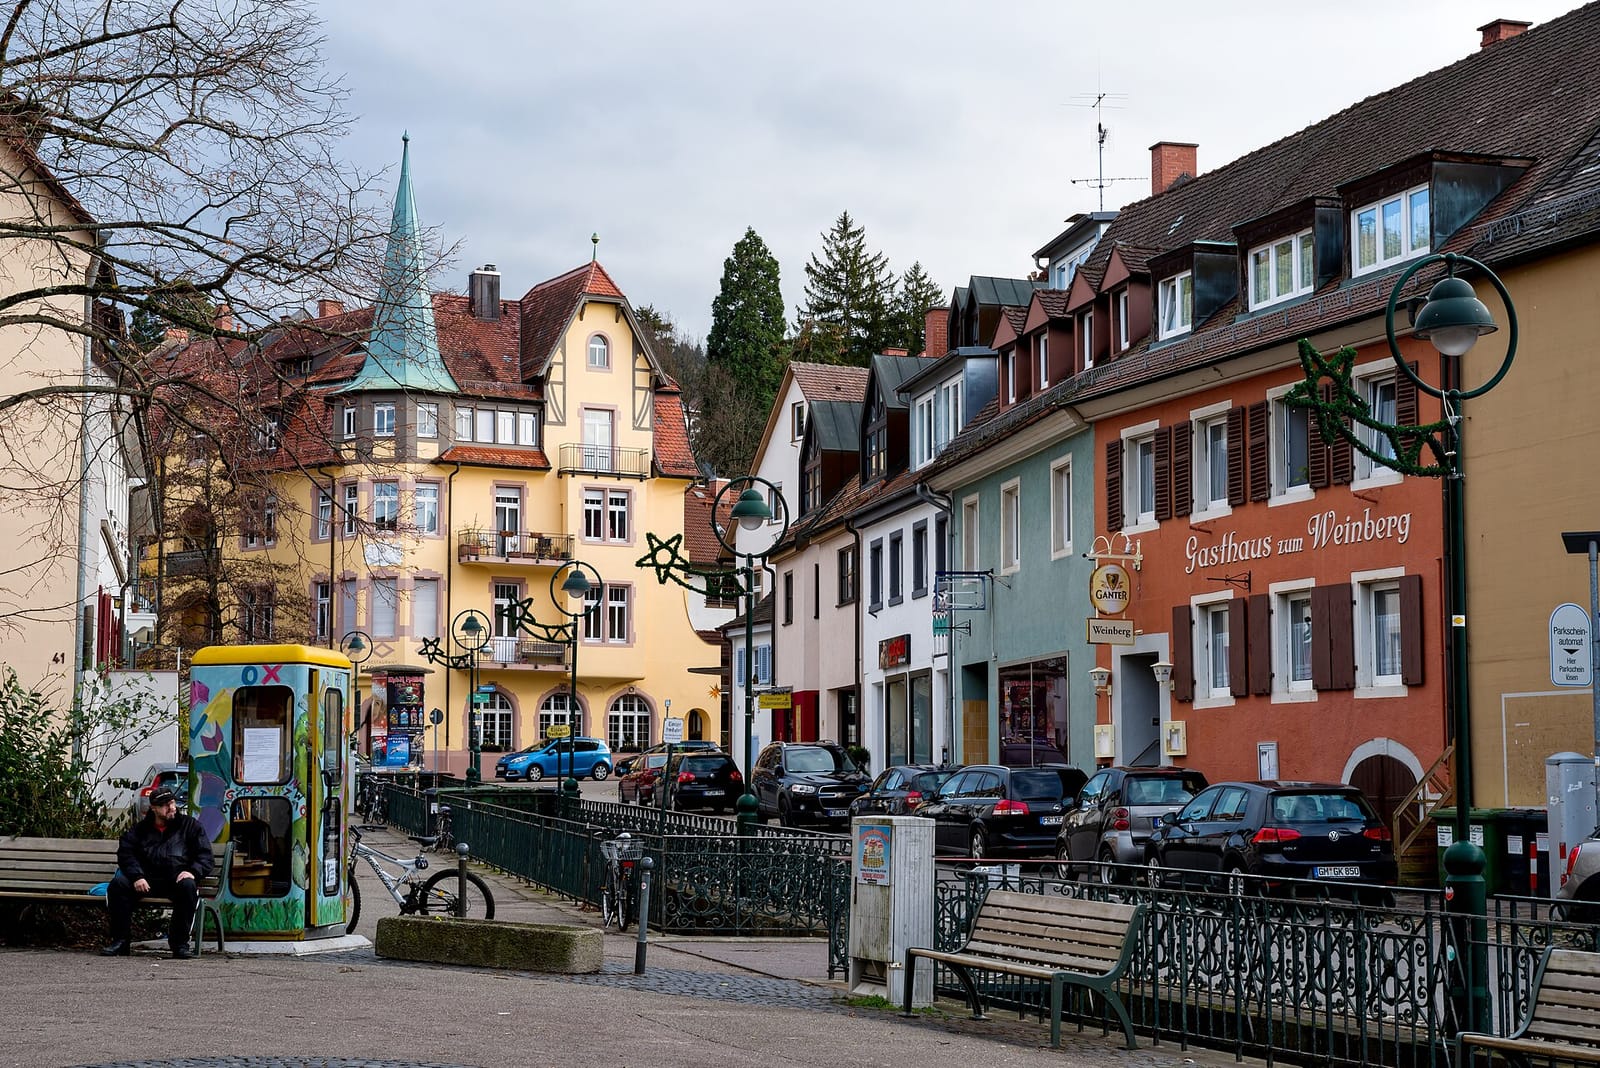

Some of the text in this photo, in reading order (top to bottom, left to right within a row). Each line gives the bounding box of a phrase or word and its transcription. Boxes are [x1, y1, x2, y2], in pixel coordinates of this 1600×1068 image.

[1185, 508, 1412, 574] Gasthaus zum Weinberg
[1096, 590, 1127, 600] GANTER
[1092, 625, 1131, 638] Weinberg
[1553, 627, 1588, 635] Parkschein-
[1558, 638, 1583, 646] automat
[52, 652, 65, 664] 41
